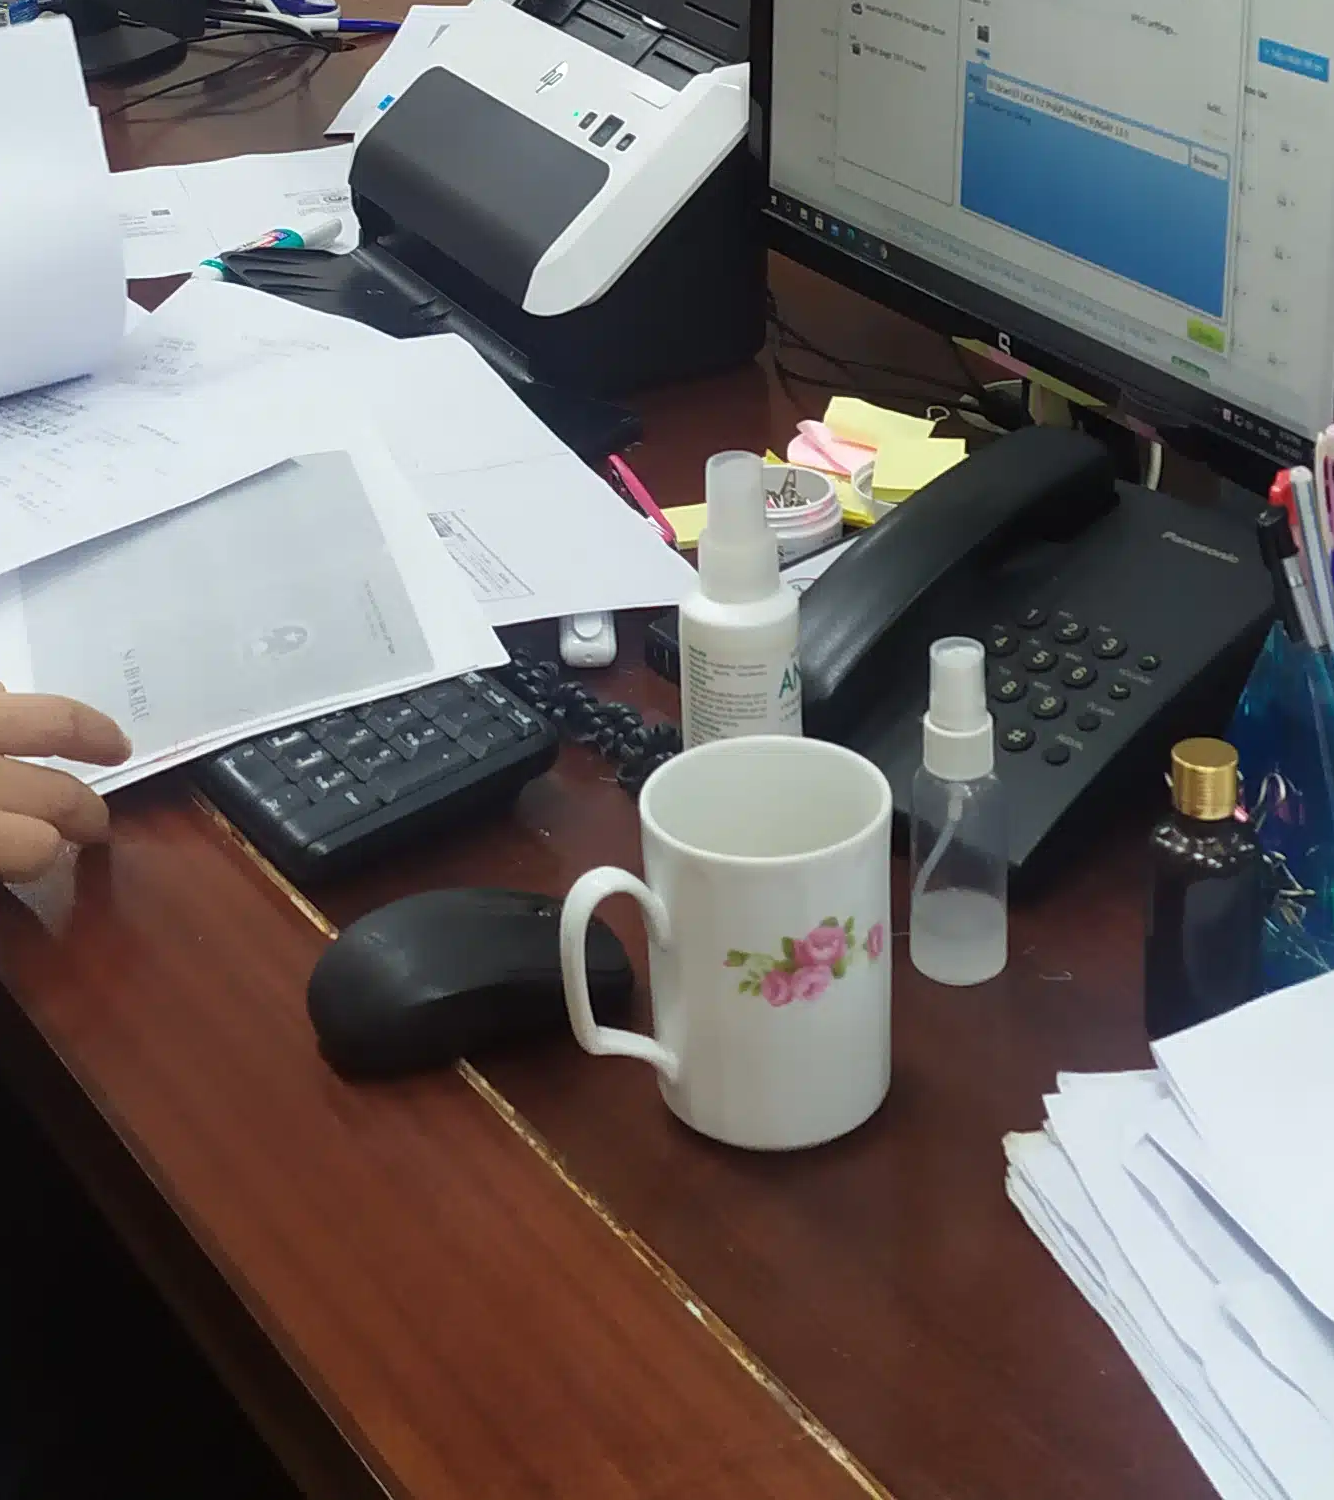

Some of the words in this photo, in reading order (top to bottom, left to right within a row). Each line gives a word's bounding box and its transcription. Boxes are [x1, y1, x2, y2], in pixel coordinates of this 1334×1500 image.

[1161, 531, 1239, 564] Panasonic
[1027, 608, 1039, 620] 1
[1062, 622, 1078, 635] 2
[995, 636, 1009, 648] 4
[1101, 638, 1118, 650] 3
[1032, 651, 1049, 664] 5
[1071, 666, 1087, 680] 6
[1001, 680, 1017, 695] 8
[1040, 696, 1056, 710] 9
